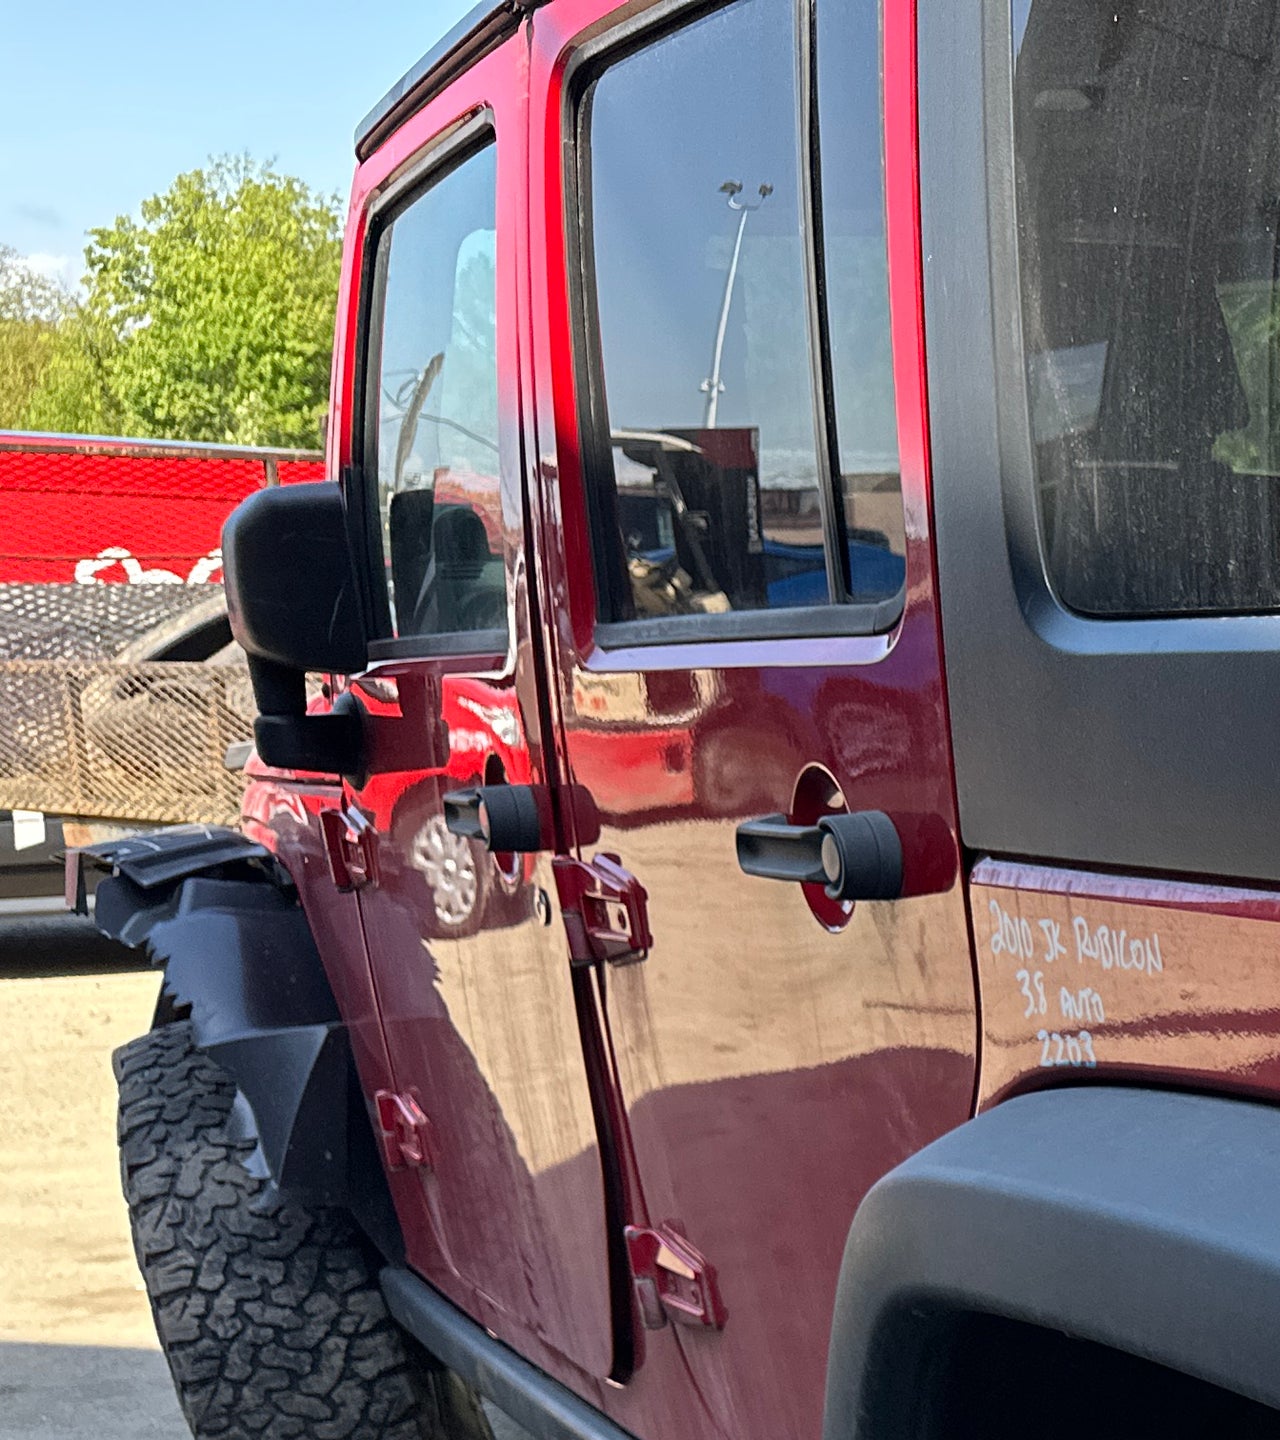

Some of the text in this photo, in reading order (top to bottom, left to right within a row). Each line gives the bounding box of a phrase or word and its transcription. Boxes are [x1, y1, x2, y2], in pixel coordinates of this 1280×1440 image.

[989, 899, 1034, 961] 2010
[1073, 915, 1163, 976] RUBICON
[1016, 969, 1105, 1023] 3.8 AUTO
